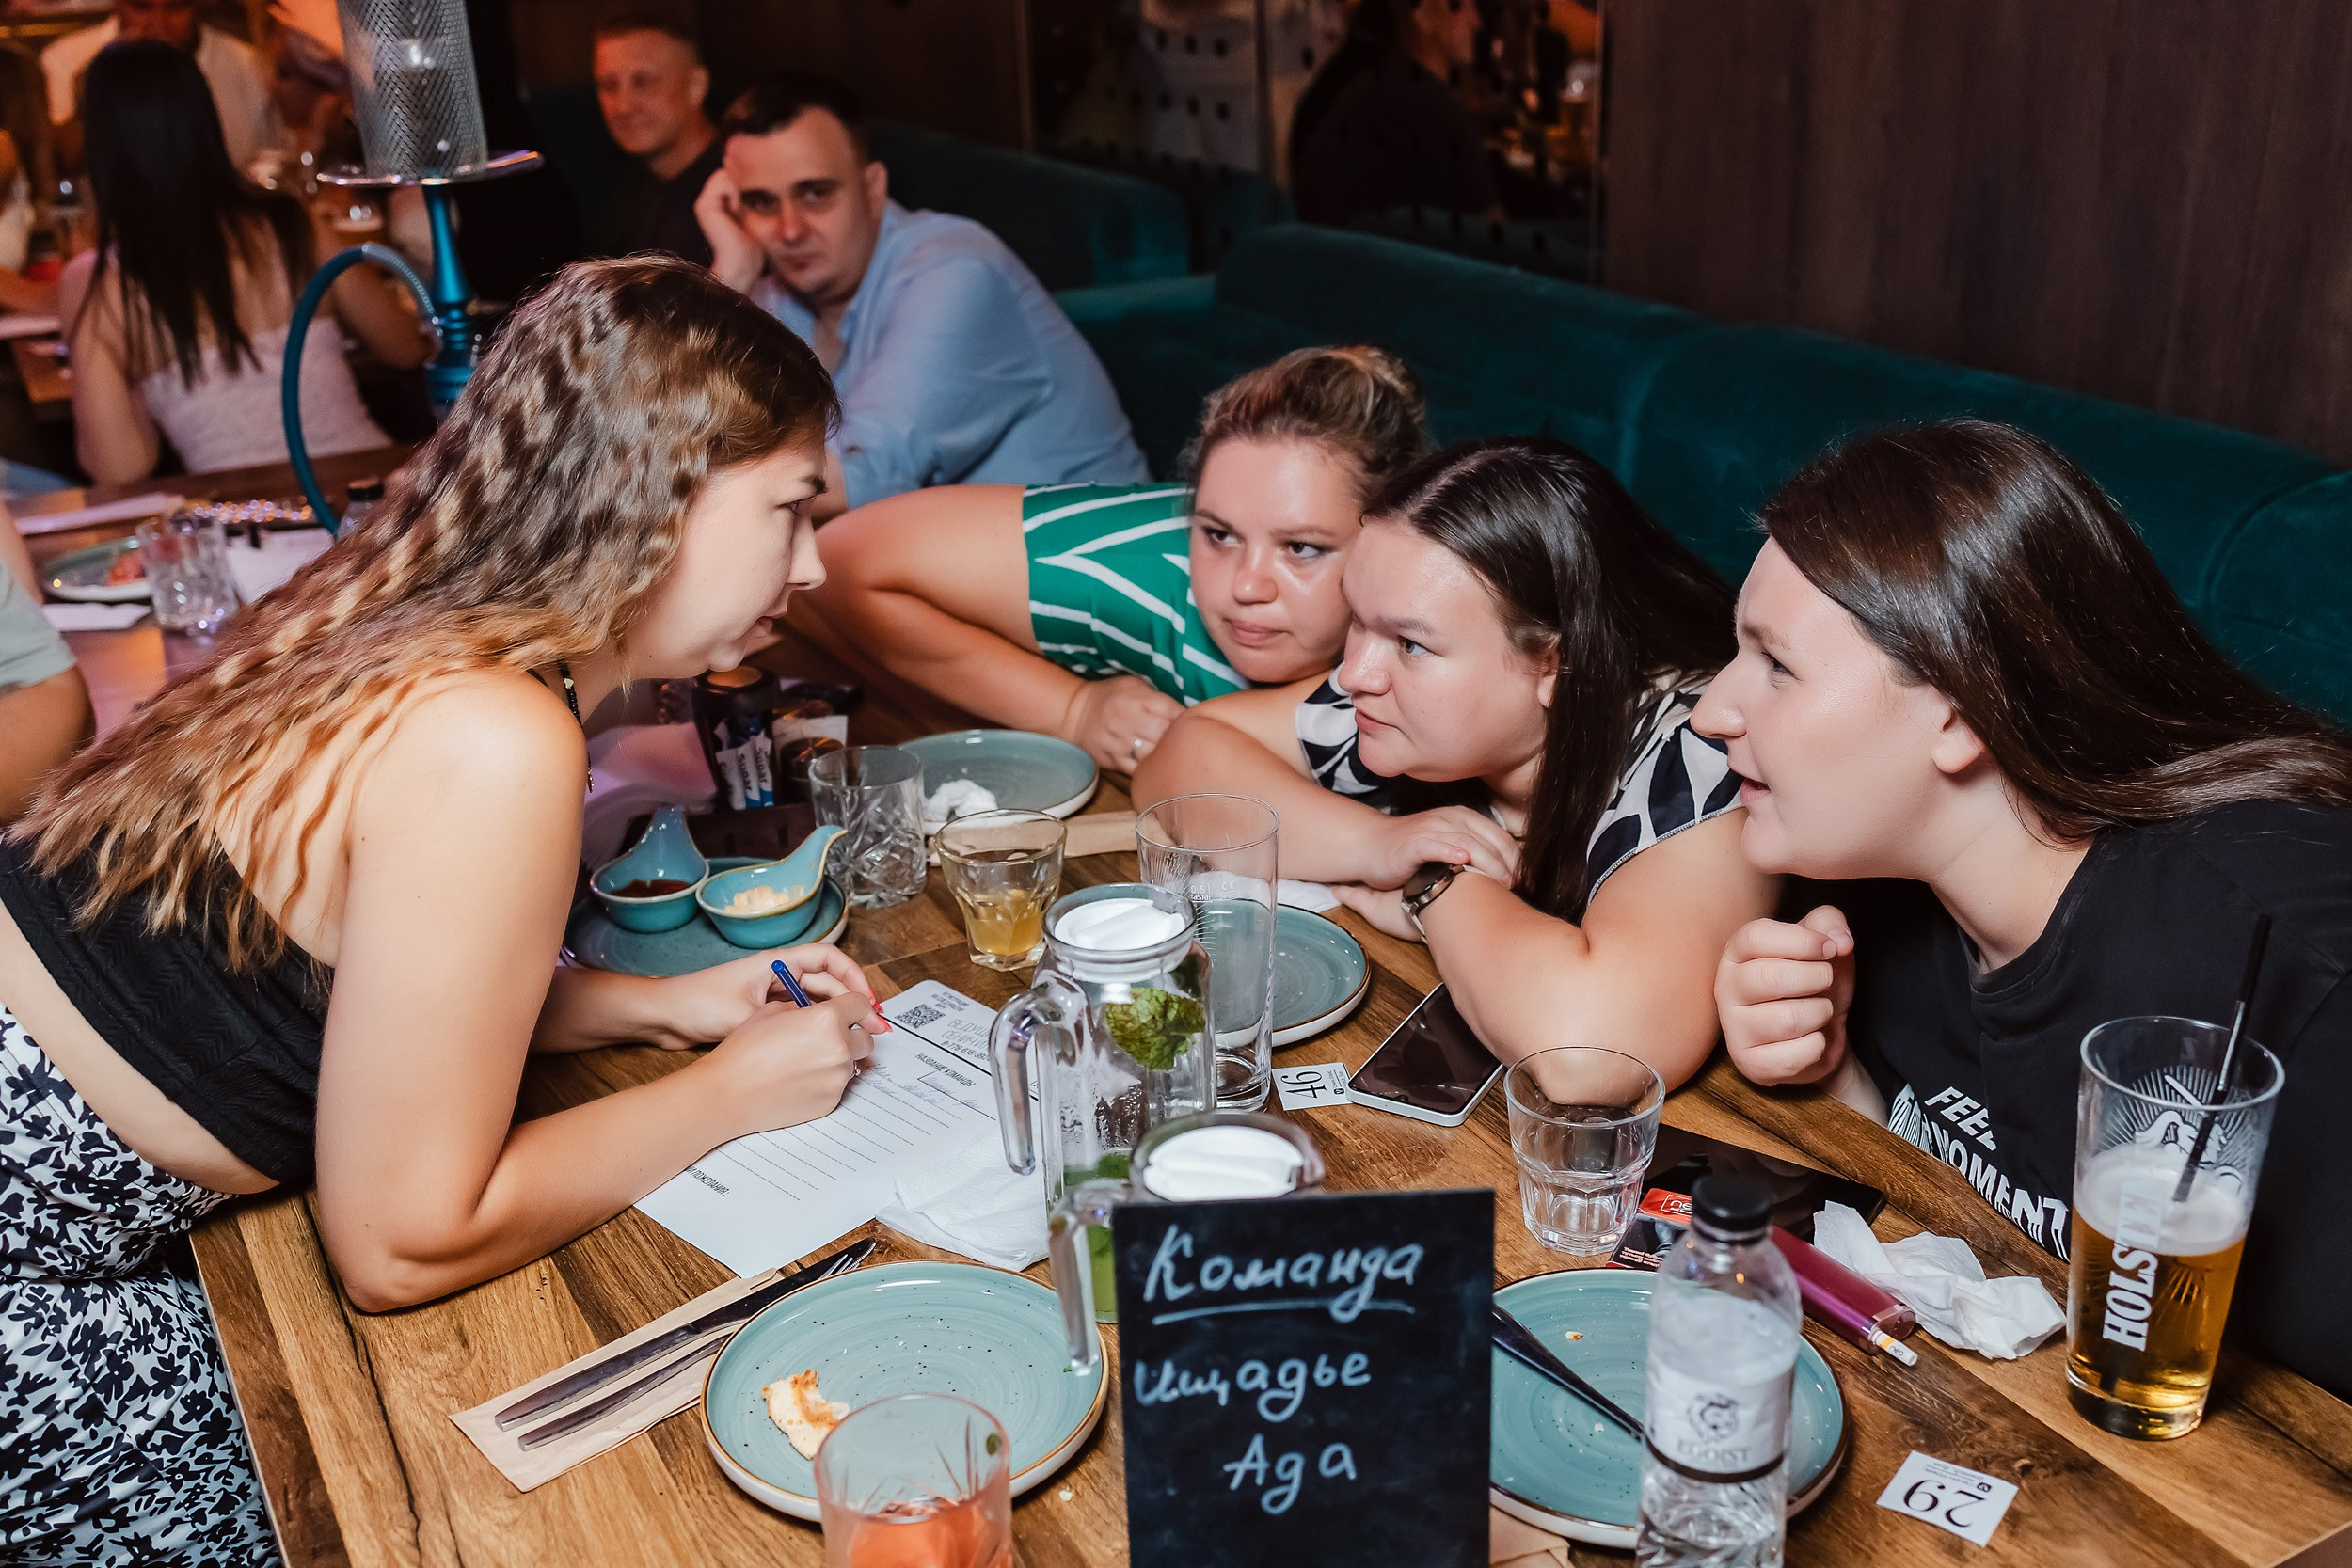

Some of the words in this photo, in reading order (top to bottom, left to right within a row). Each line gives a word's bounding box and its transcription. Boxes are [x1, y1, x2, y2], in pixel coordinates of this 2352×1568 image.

[1280, 1071, 1327, 1099] 46
[1143, 1225, 1424, 1323] Команда
[1224, 1433, 1357, 1515] Ада
[1903, 1479, 1986, 1528] 29
